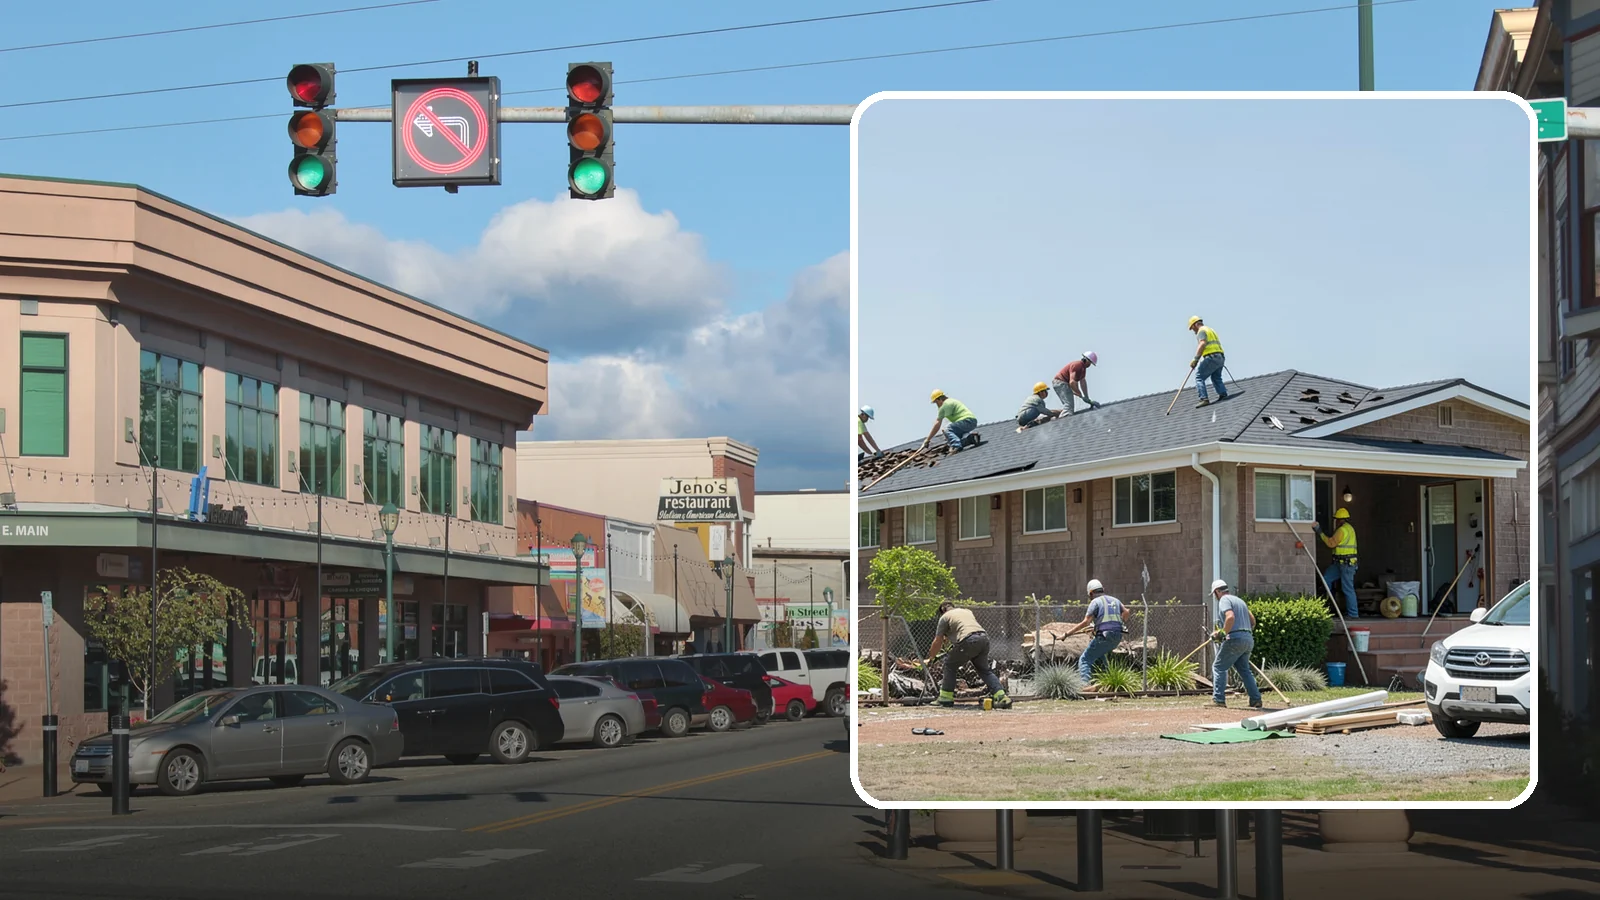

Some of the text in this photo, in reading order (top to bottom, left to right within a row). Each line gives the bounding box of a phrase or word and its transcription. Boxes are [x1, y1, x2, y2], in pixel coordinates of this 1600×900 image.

[669, 480, 728, 494] Jeno's
[665, 496, 731, 509] restaurant
[659, 510, 682, 519] Italian
[686, 509, 714, 519] American
[715, 509, 738, 519] Cuisine
[2, 525, 49, 536] E. MAIN
[797, 607, 828, 616] Street
